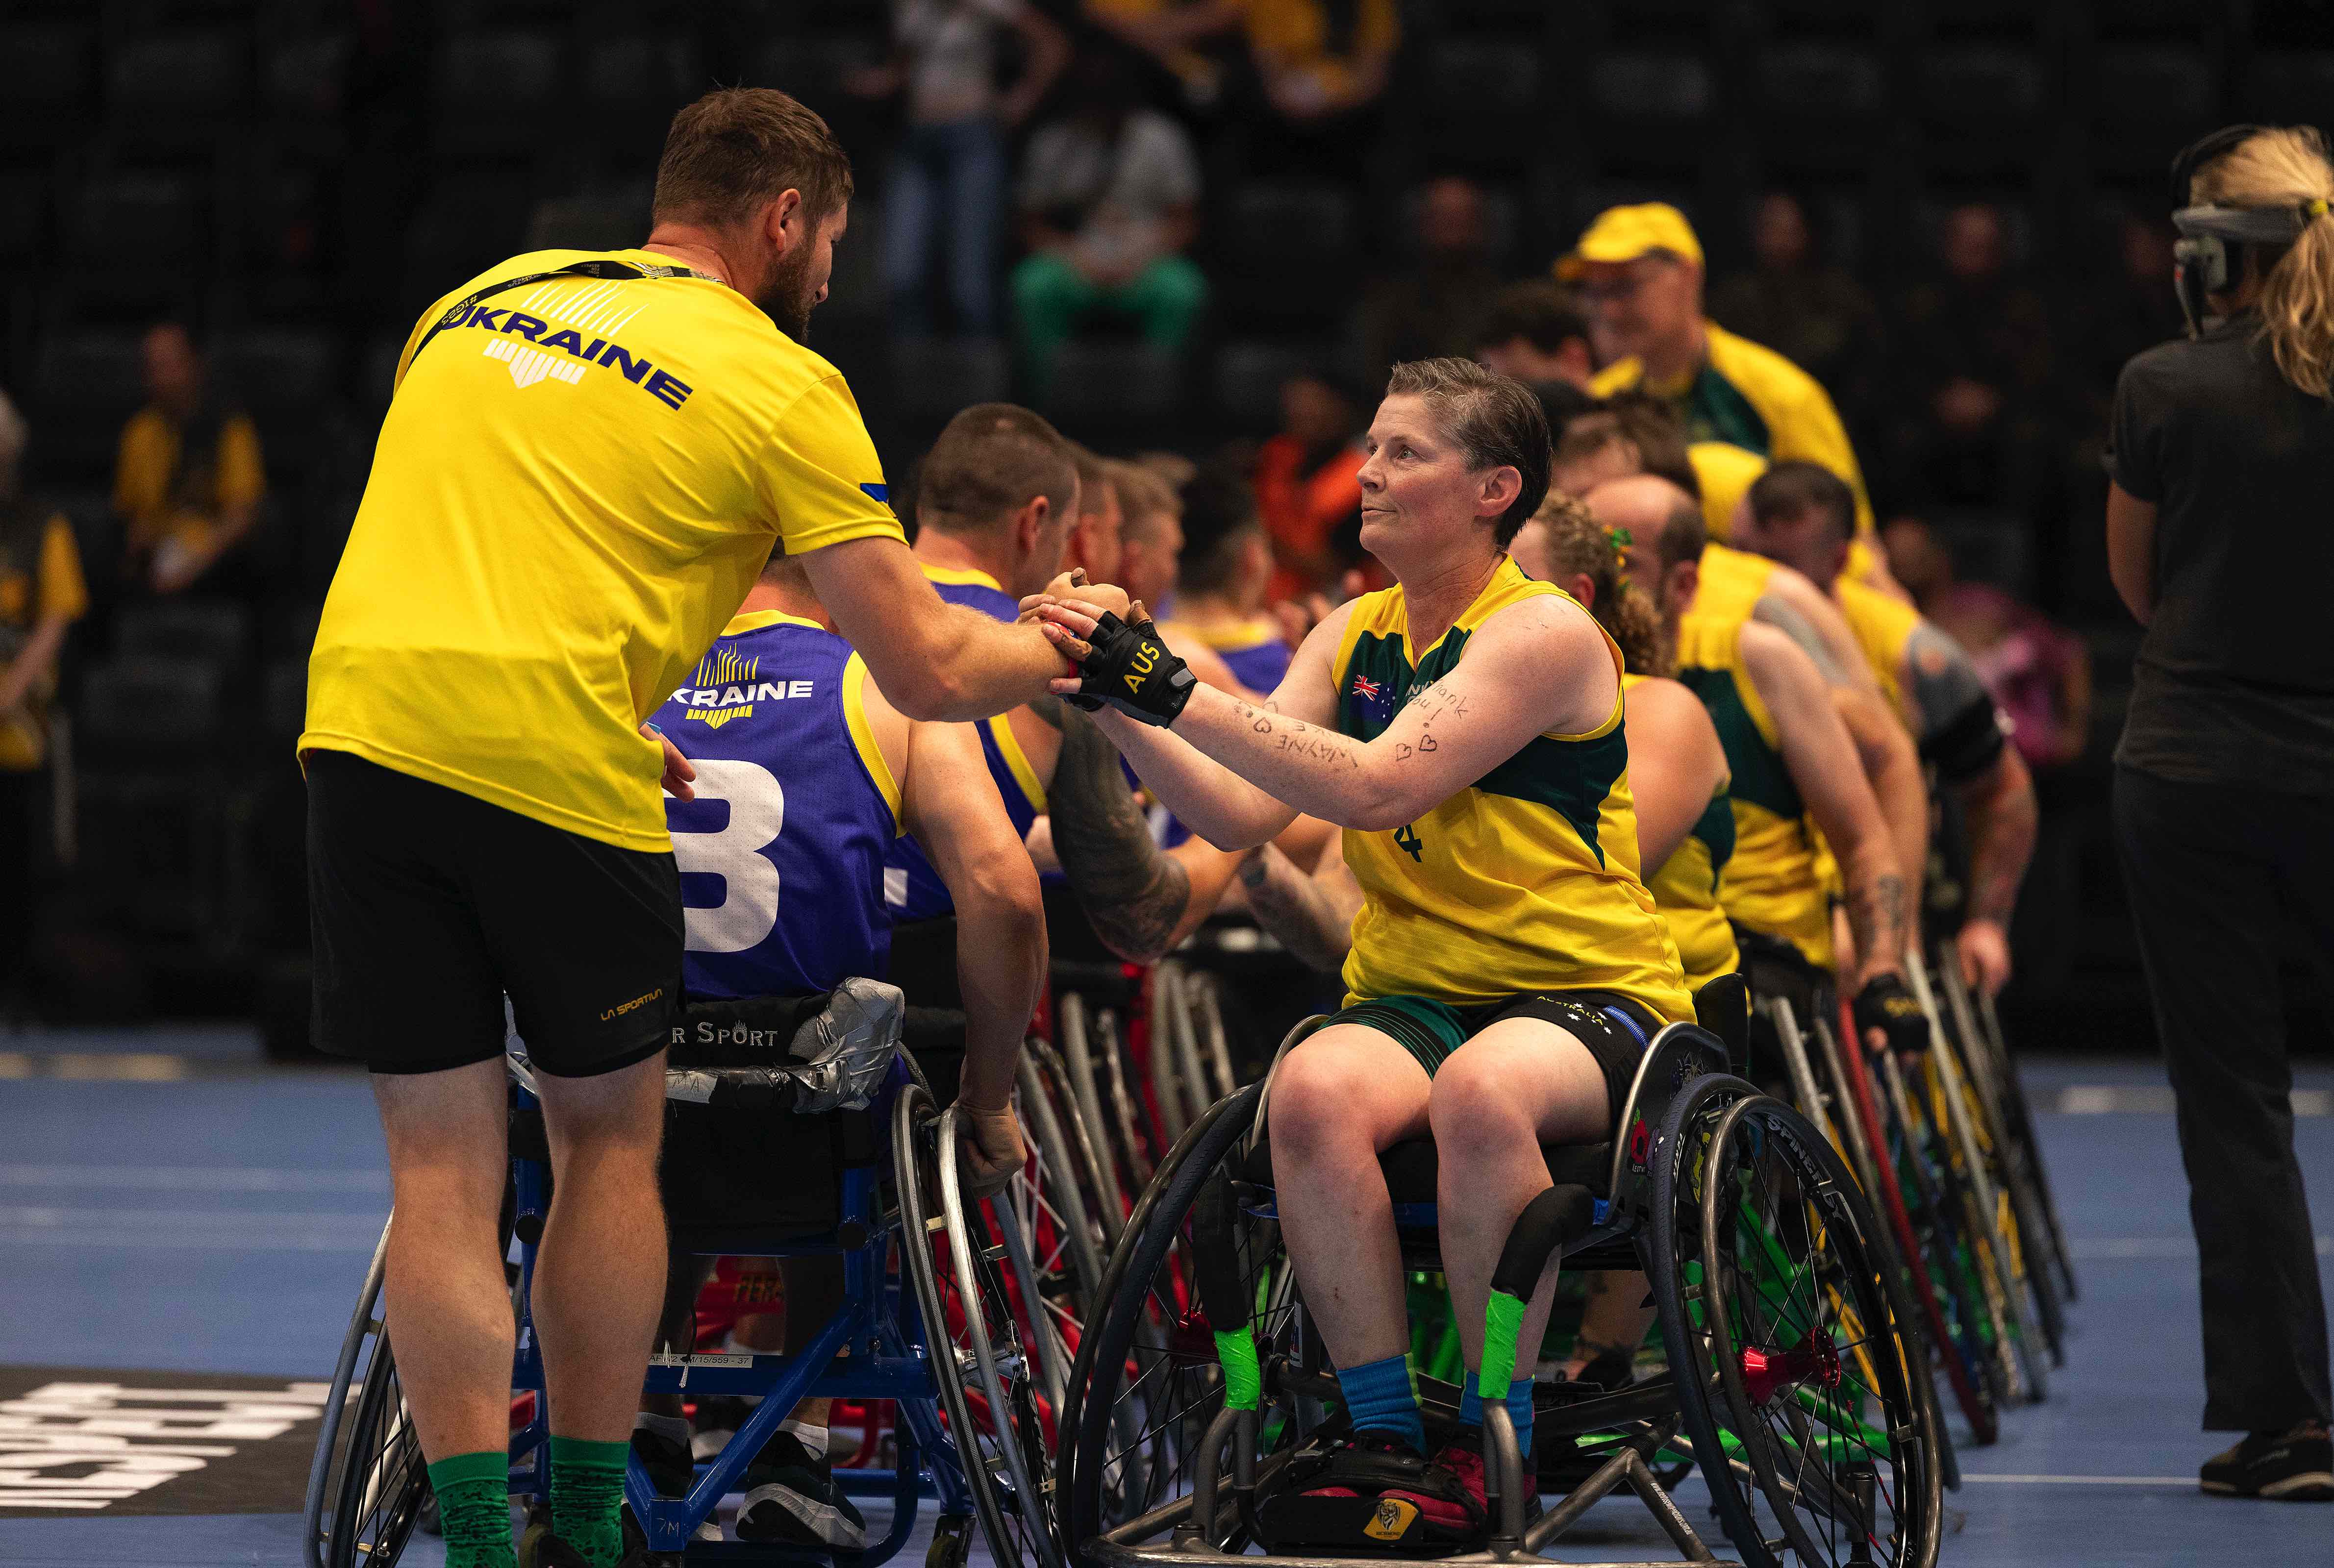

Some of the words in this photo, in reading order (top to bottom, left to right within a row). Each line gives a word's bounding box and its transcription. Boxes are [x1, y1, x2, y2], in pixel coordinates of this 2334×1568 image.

[441, 295, 478, 326] #IG23
[1124, 642, 1160, 694] AUS
[667, 680, 813, 707] KRAINE
[1276, 734, 1358, 768] WAYNE
[600, 1008, 616, 1021] LA
